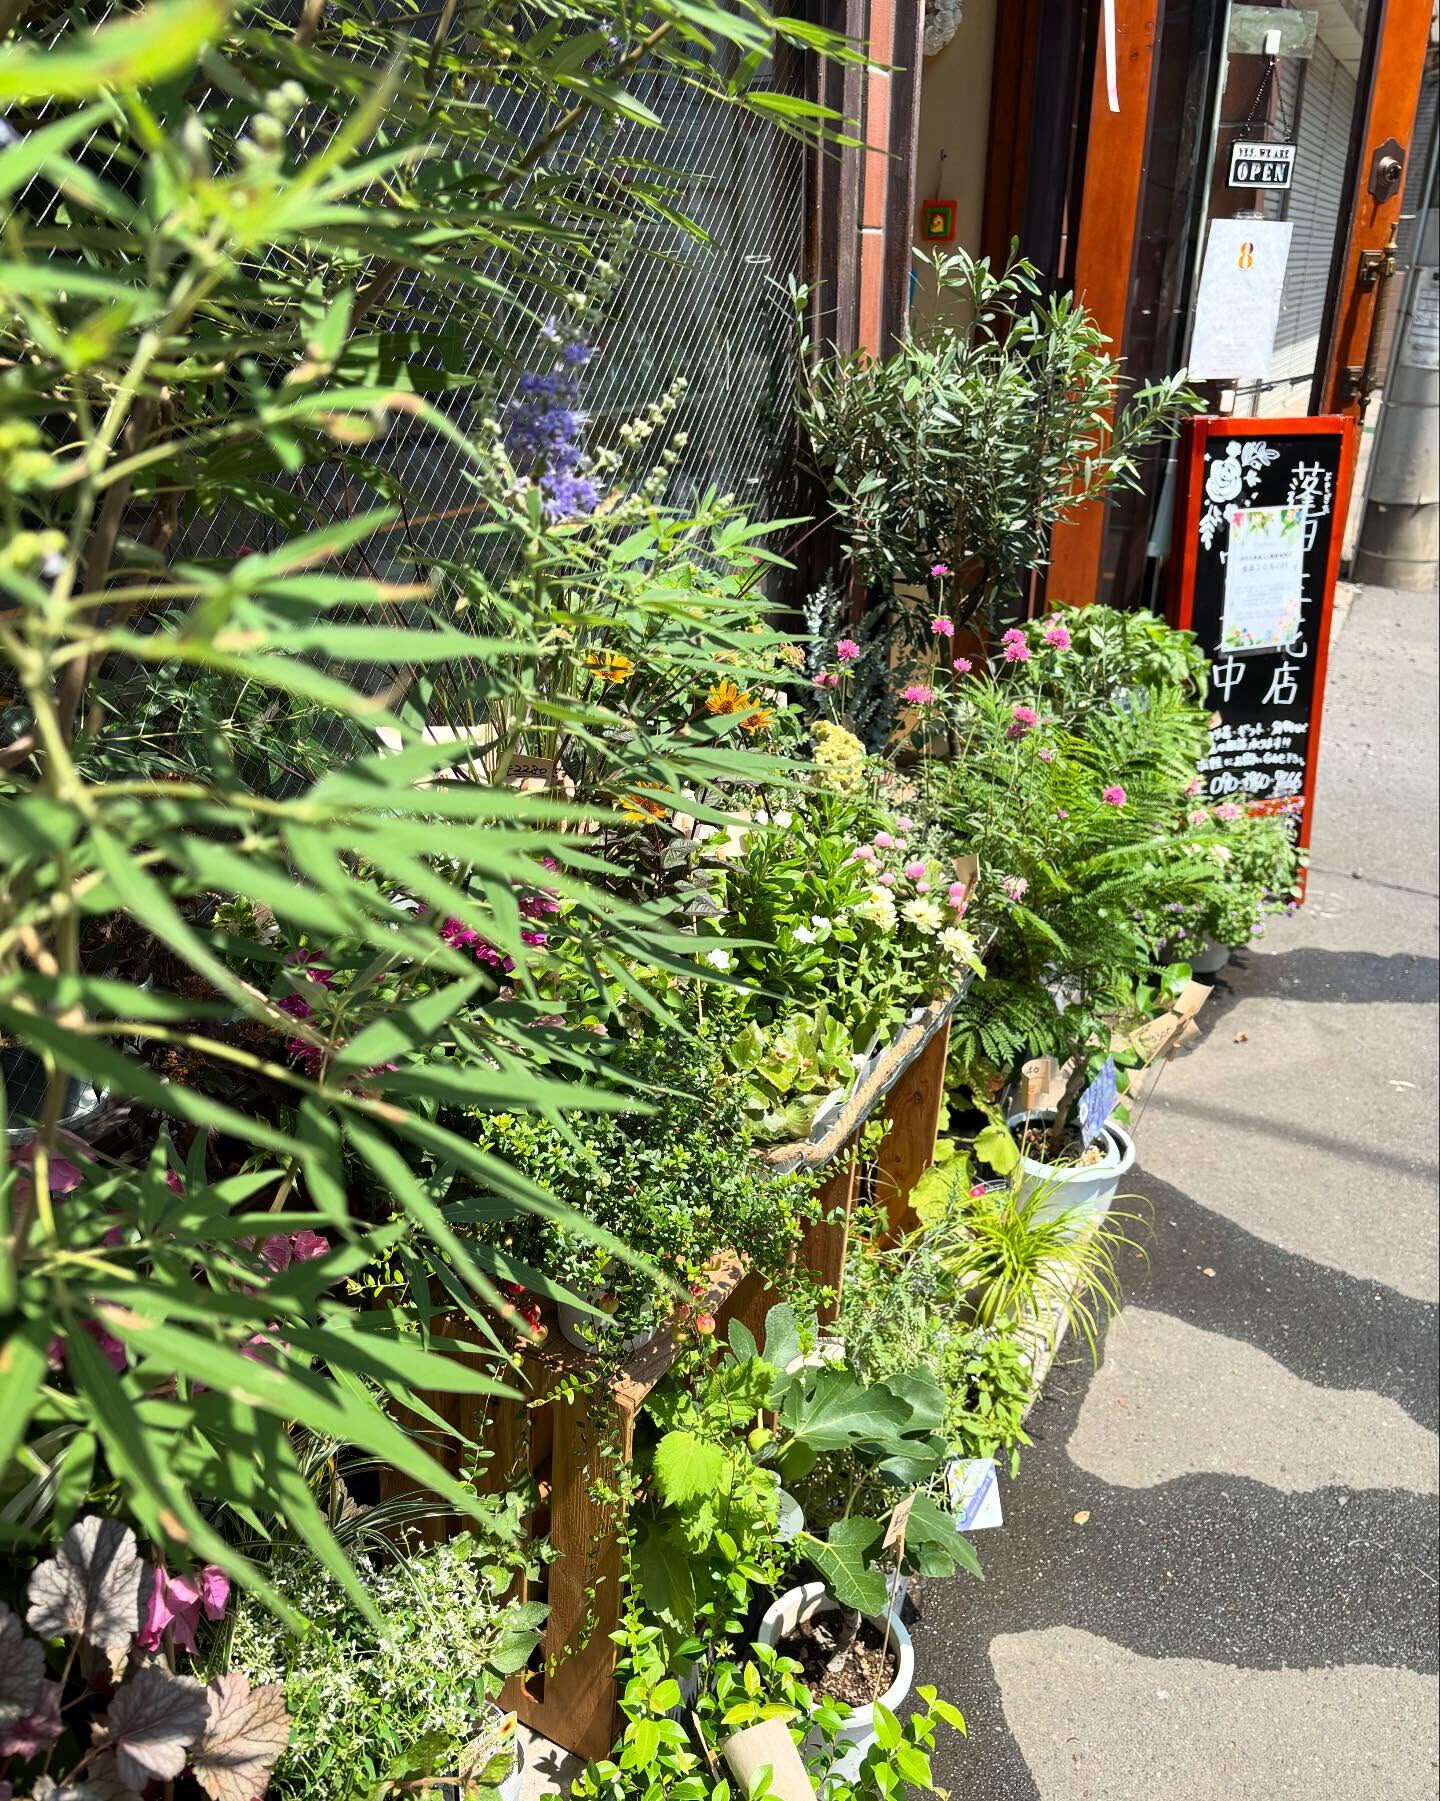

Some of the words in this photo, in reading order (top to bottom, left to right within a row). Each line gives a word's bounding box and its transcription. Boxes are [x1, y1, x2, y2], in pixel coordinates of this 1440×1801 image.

[1259, 147, 1272, 159] WE
[1273, 148, 1290, 159] ARE
[1237, 161, 1287, 183] OPEN
[1237, 241, 1254, 270] 8
